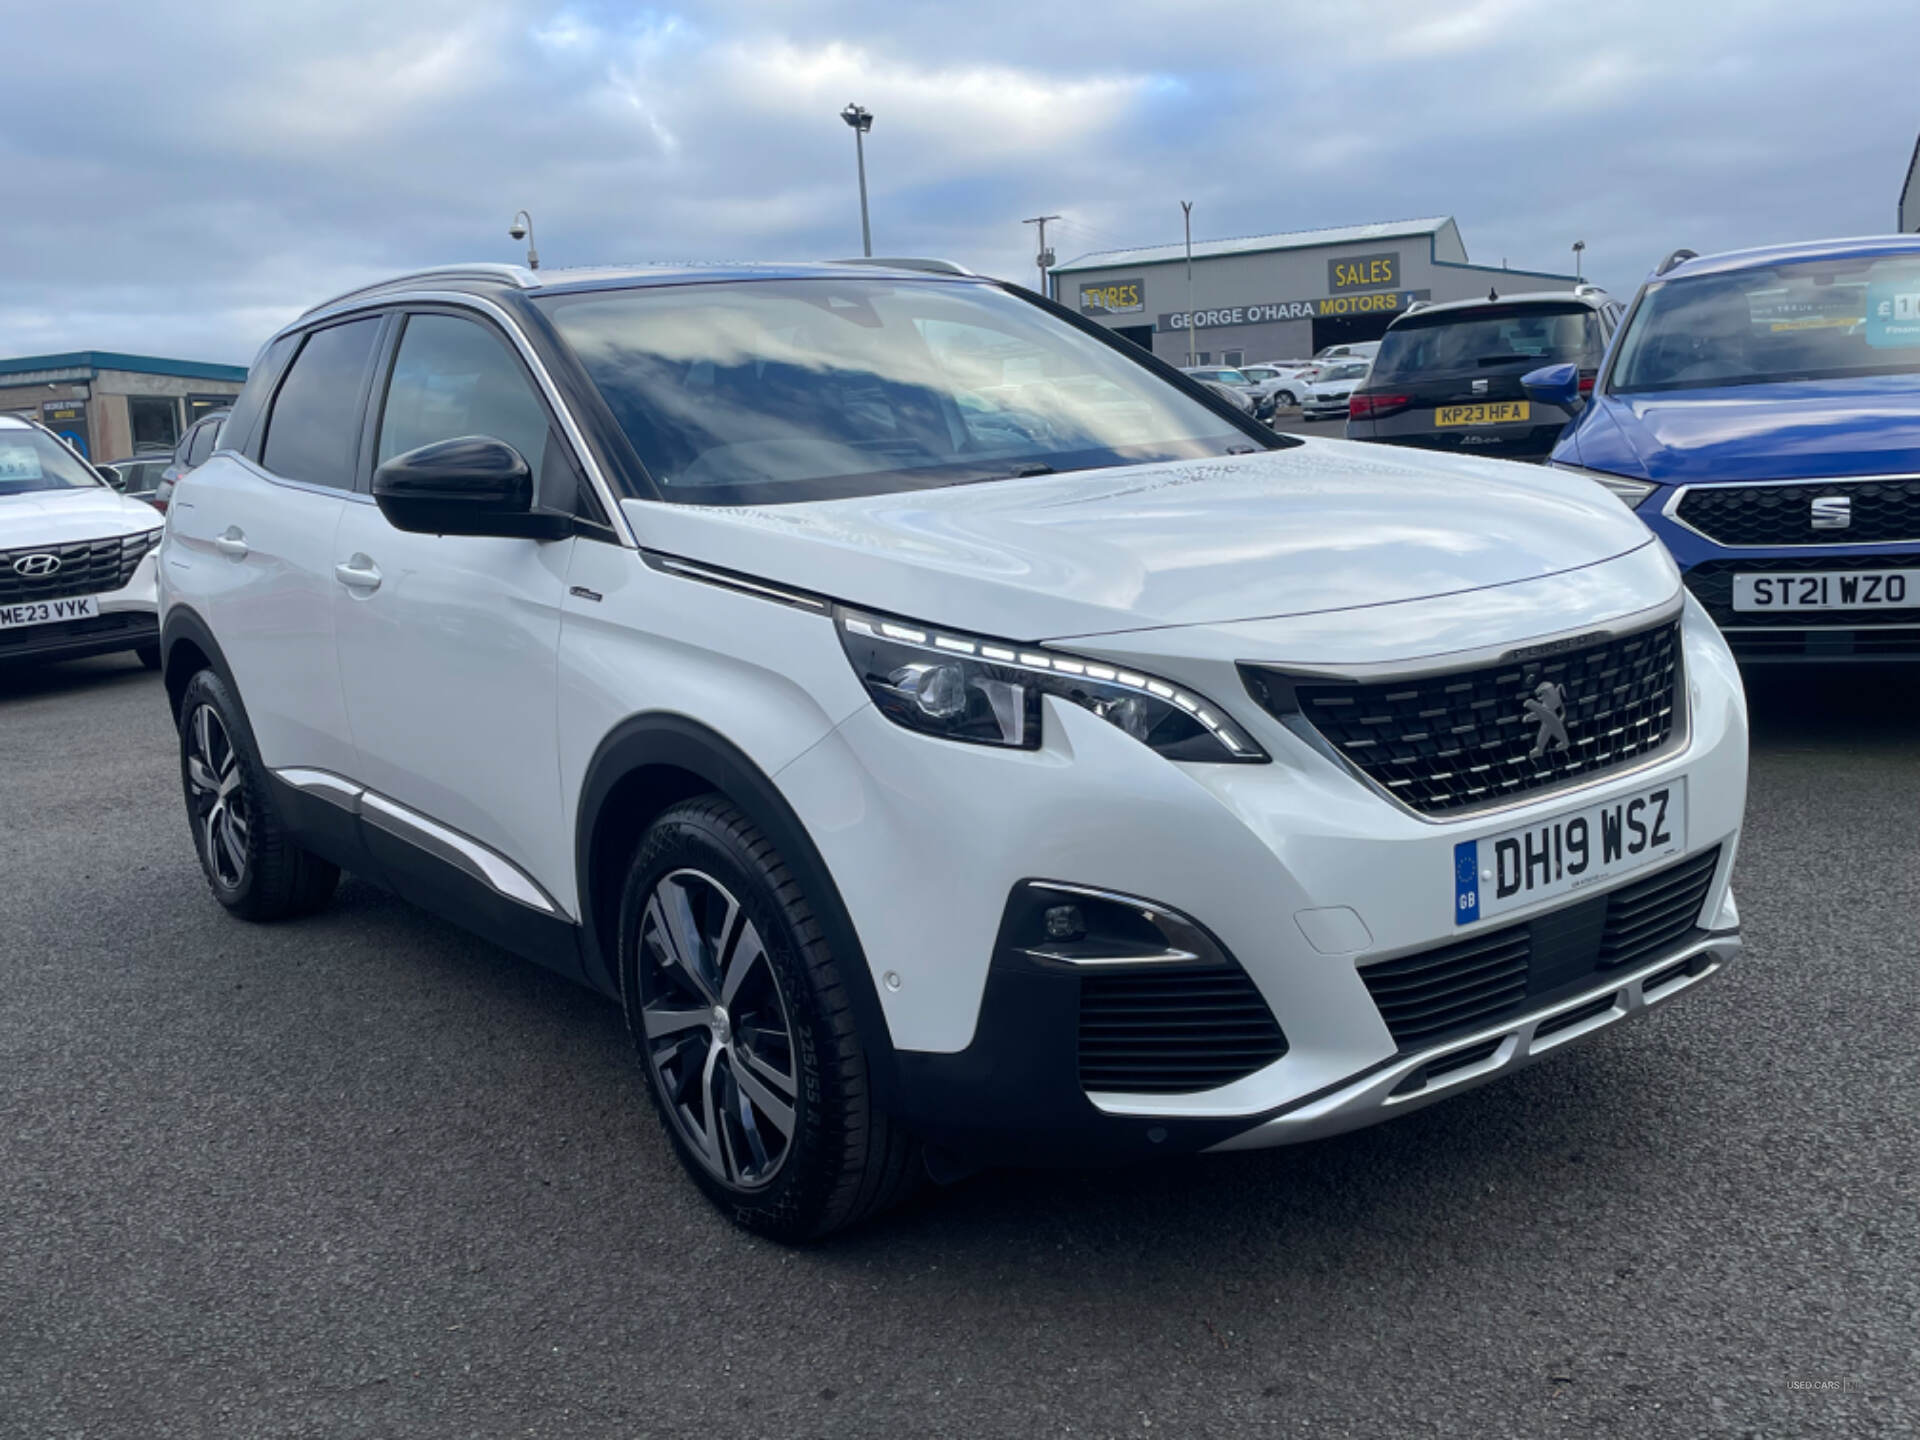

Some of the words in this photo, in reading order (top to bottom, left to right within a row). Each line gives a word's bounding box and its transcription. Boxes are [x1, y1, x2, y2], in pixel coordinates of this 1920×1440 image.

[1336, 260, 1392, 287] SALES
[1085, 284, 1139, 309] TYRES
[1170, 308, 1243, 329] GEORGE
[1248, 302, 1315, 322] O'HARA
[1319, 294, 1398, 315] MOTORS
[1441, 406, 1485, 424] KP23
[1489, 403, 1521, 420] HFA
[1753, 576, 1828, 606] ST21
[1839, 575, 1906, 604] WZO
[0, 604, 50, 625] ME23
[54, 599, 91, 618] VYK
[1494, 817, 1590, 899] DH19
[1601, 788, 1672, 865] WSZ
[1459, 891, 1476, 910] GB
